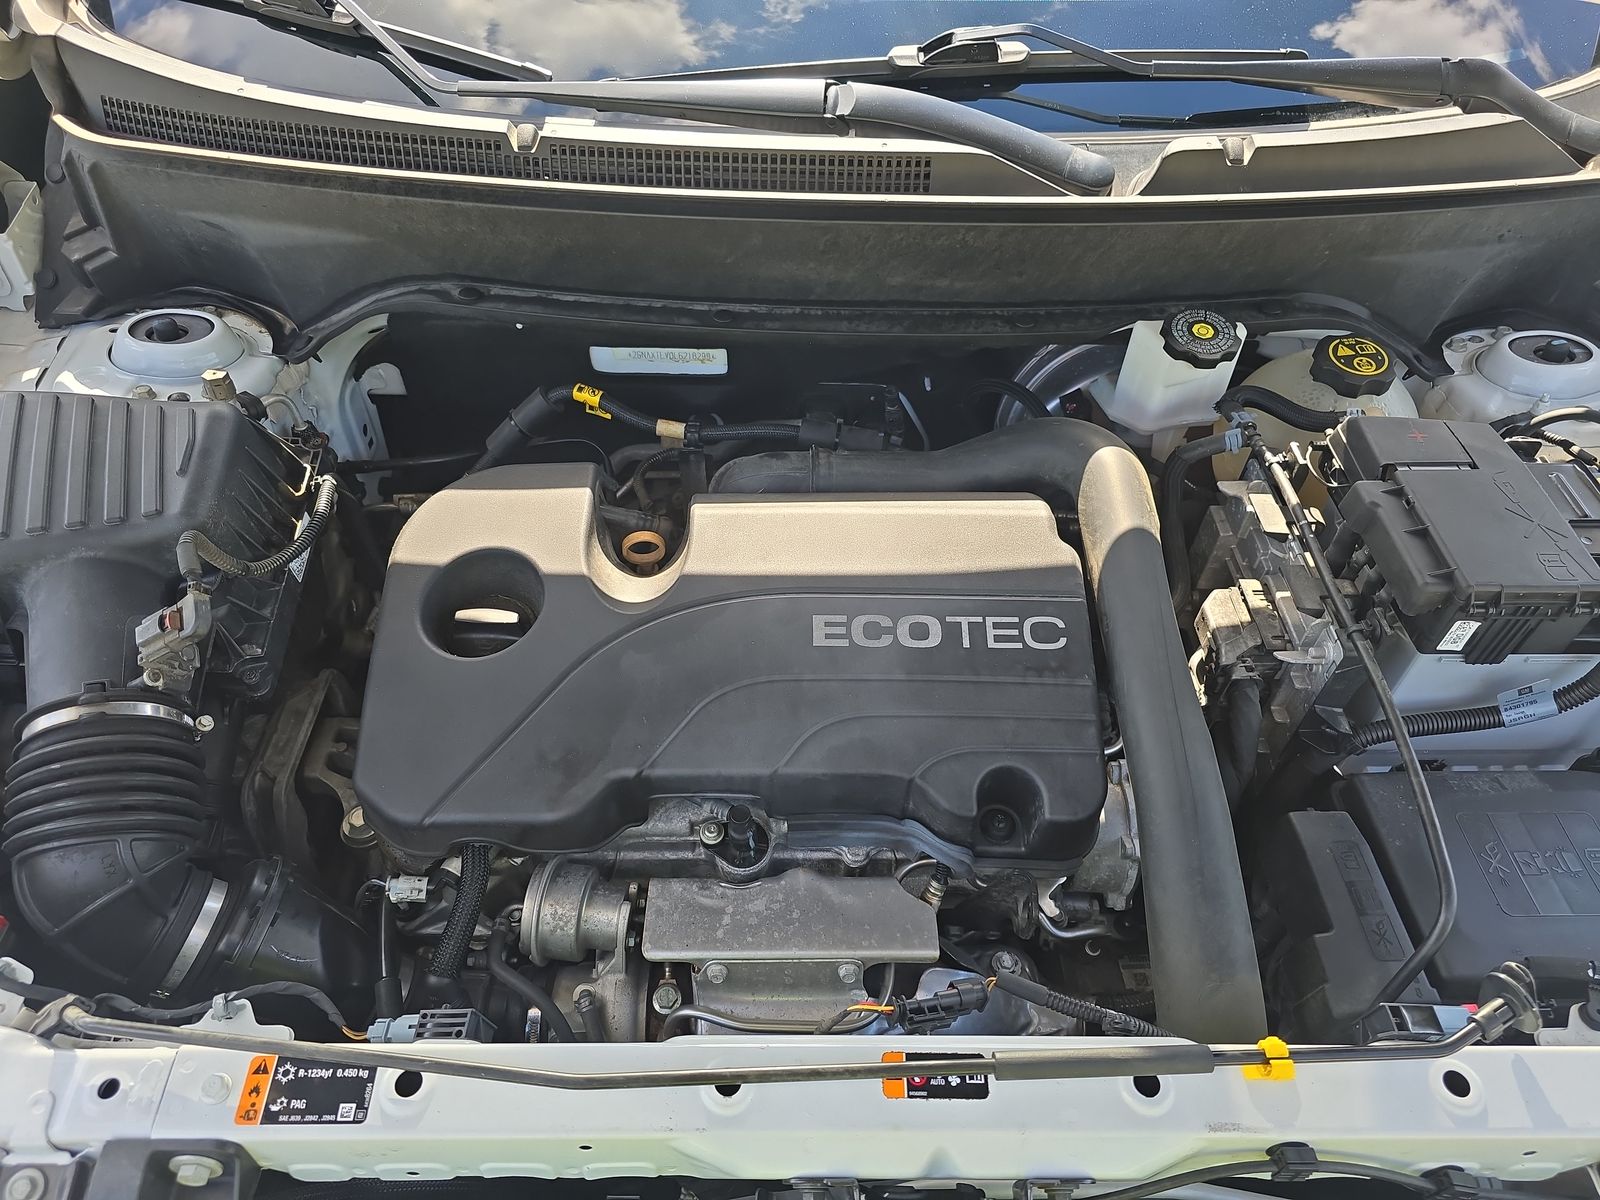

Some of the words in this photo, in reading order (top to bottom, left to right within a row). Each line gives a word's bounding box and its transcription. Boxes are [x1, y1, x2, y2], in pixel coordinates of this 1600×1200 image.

[812, 614, 1067, 650] ECOTEC
[298, 1068, 333, 1079] R-1234yf
[336, 1068, 358, 1078] 0.450
[358, 1069, 369, 1079] kg
[290, 1099, 307, 1109] PAG
